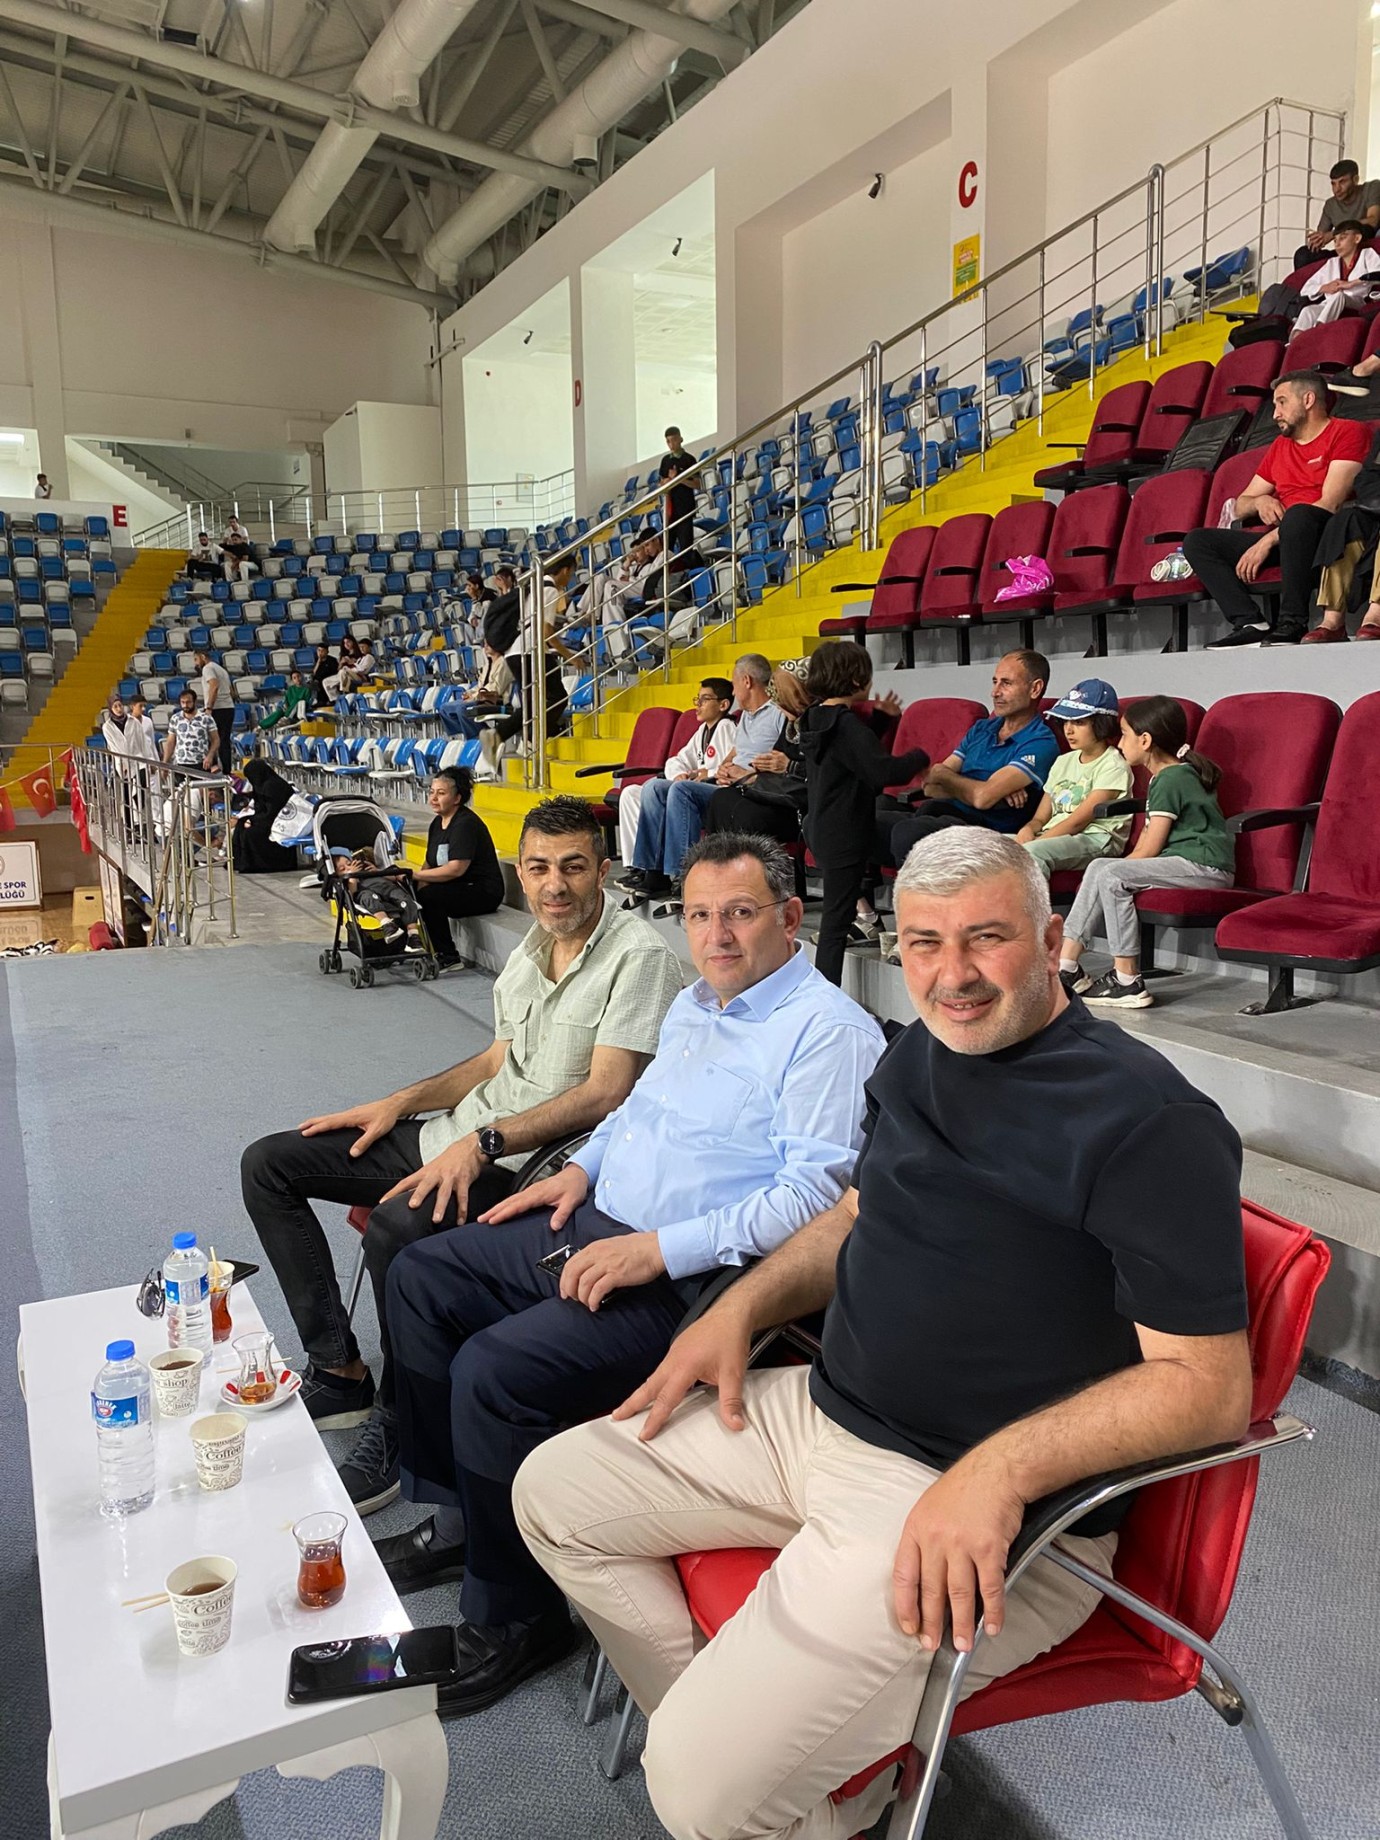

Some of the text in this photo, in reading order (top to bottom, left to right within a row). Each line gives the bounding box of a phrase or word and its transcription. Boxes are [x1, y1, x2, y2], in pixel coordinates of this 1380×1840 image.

[958, 160, 978, 209] C
[574, 379, 582, 408] D
[112, 504, 128, 527] E
[3, 881, 27, 889] SPOR
[163, 1378, 188, 1388] shop
[205, 1445, 242, 1461] Coffee
